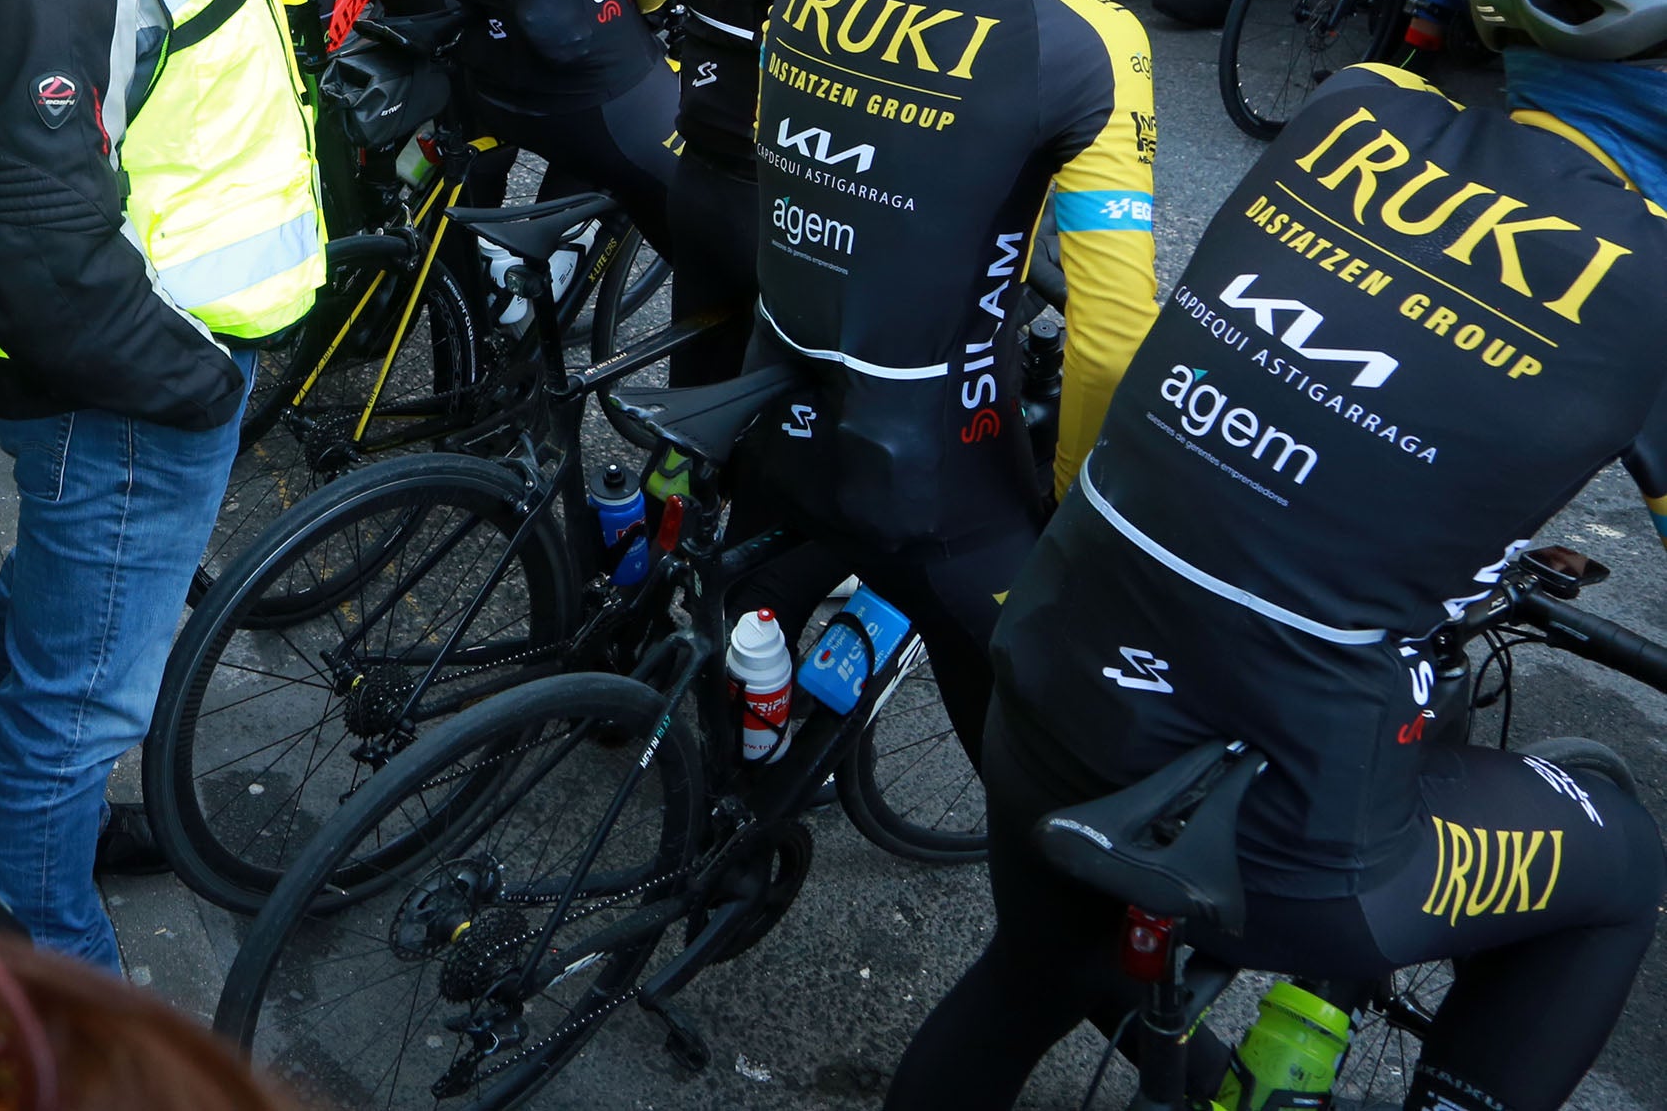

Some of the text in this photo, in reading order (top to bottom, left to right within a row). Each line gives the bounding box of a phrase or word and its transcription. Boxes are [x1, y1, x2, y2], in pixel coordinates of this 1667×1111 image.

[768, 53, 955, 132] DASTATZEN GROUP
[756, 141, 916, 212] CAPDEQUI ASTIGARRAGA
[1295, 106, 1633, 325] IRUKI
[961, 230, 1024, 410] SILAM
[1244, 195, 1544, 381] DASTATZEN GROUP
[1173, 284, 1439, 466] CAPDEQUI ASTIGARRAGA
[1186, 439, 1221, 467] gerentes
[1220, 462, 1289, 508] emprendedores
[1421, 814, 1565, 927] IRUKI
